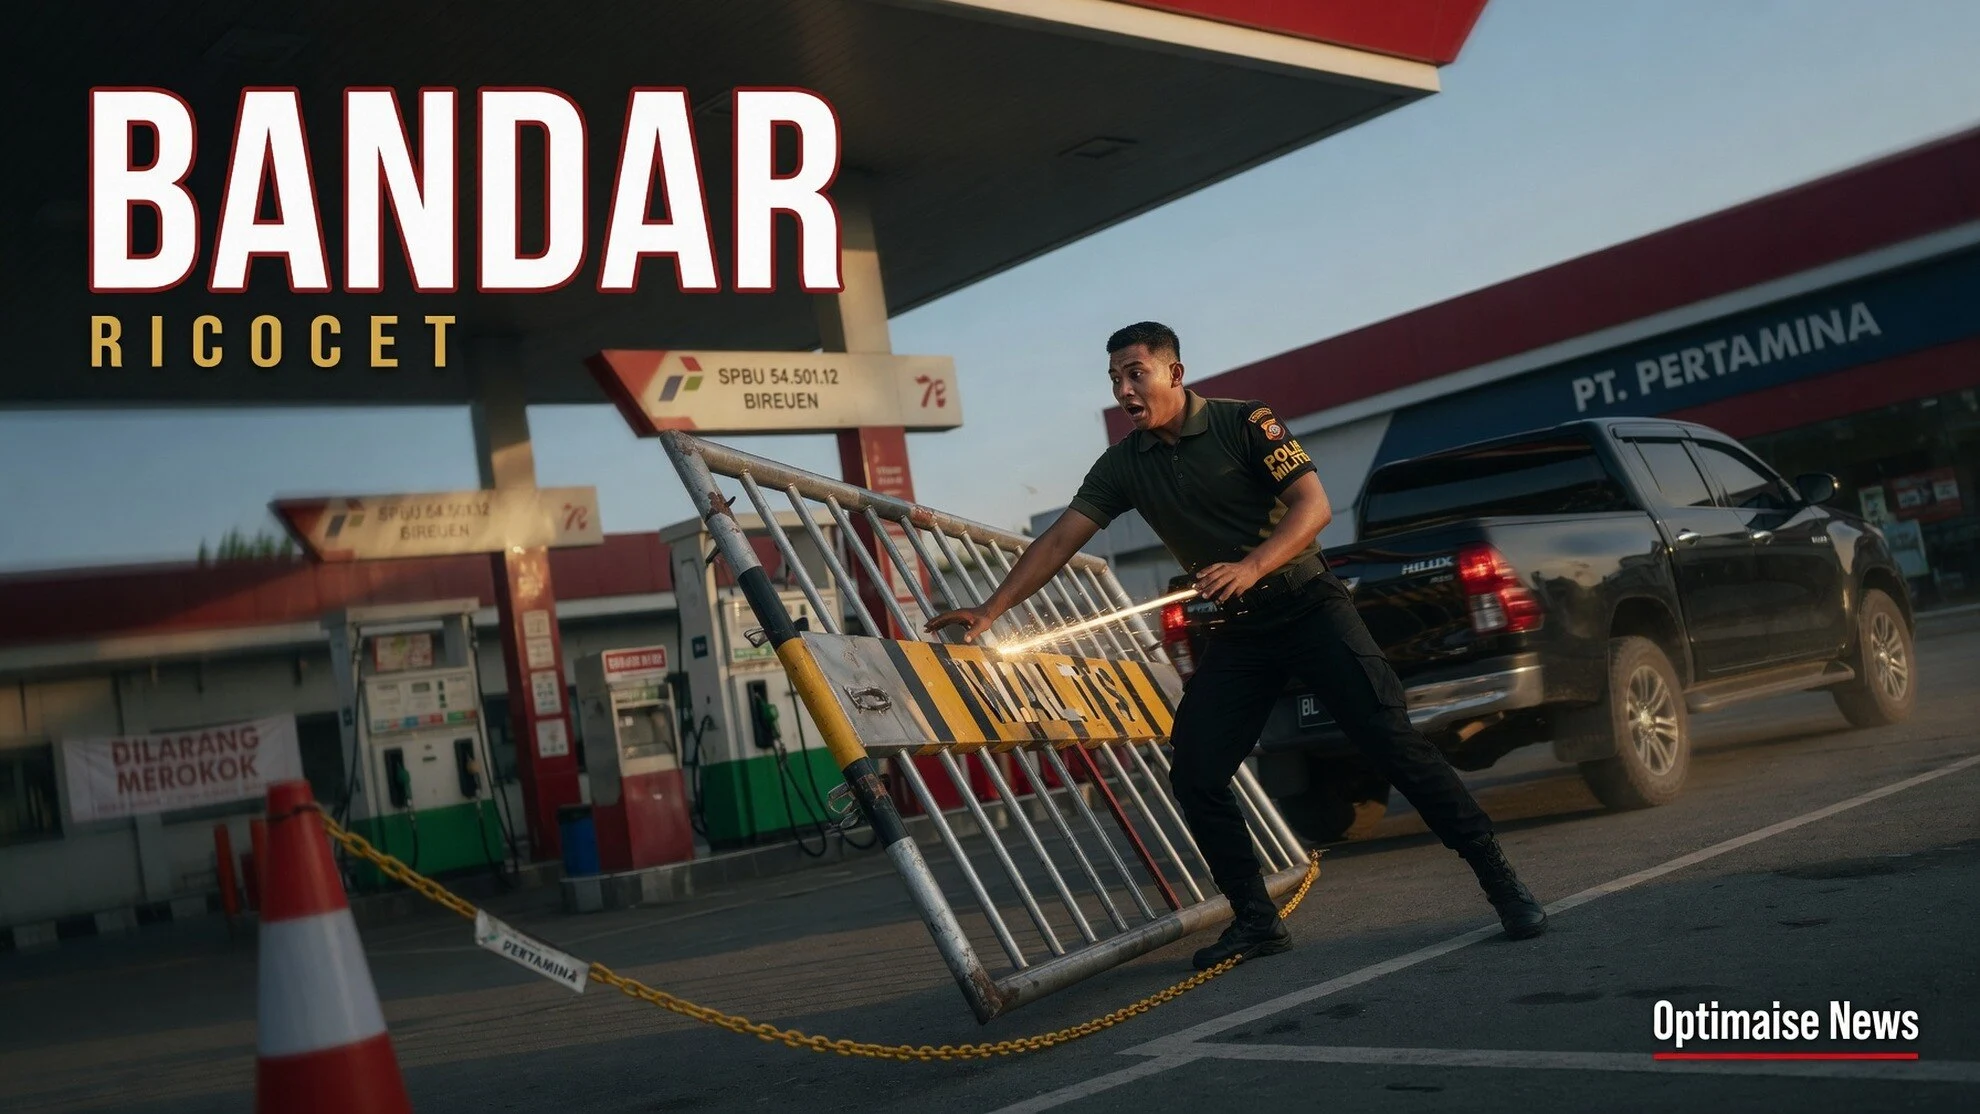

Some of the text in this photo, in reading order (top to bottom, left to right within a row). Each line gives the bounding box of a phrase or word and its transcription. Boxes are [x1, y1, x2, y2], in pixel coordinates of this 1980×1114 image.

[1572, 302, 1883, 413] PT. PERTAMINA
[718, 368, 840, 386] SPBU 54.501.12
[744, 392, 820, 410] BIREUEN
[1401, 556, 1455, 575] HILUX
[1302, 697, 1320, 716] BL
[111, 726, 260, 767] DILARANG
[117, 754, 258, 795] MEROKOK
